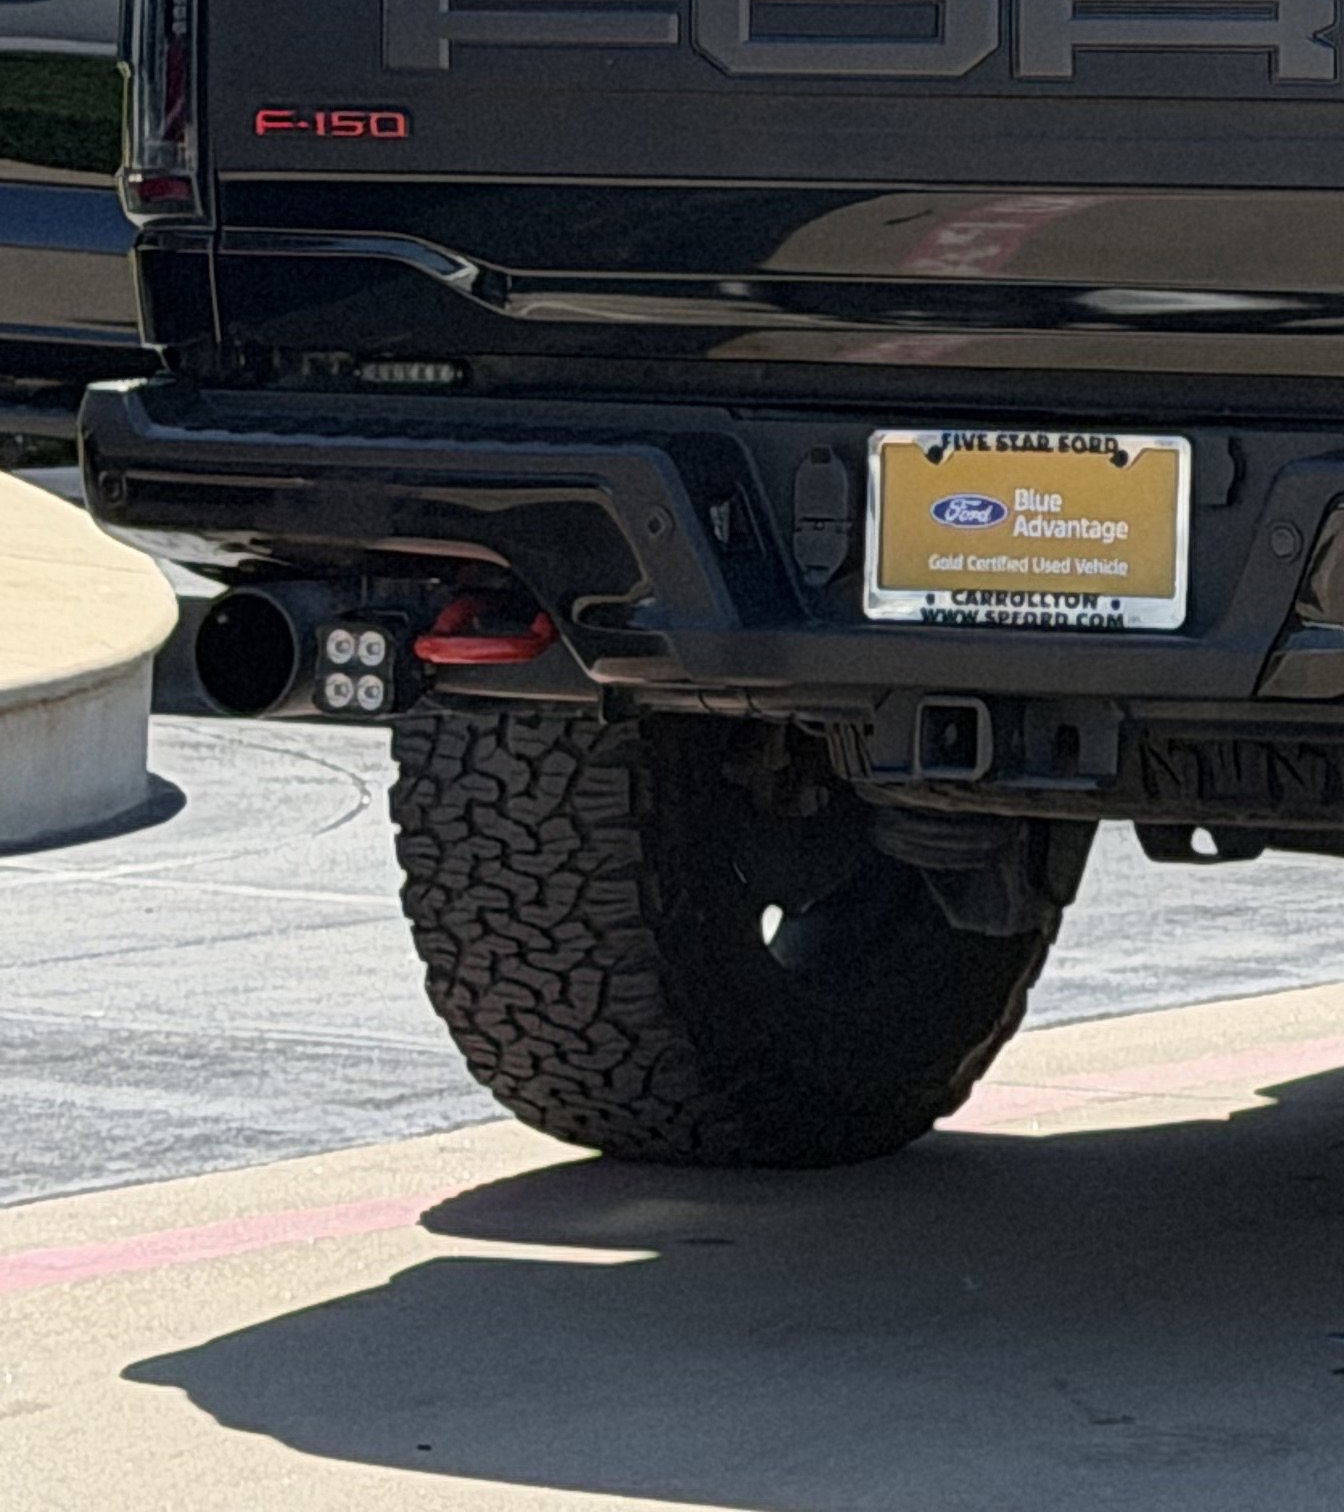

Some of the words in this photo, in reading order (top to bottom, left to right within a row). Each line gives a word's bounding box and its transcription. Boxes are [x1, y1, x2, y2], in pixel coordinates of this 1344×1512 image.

[255, 108, 409, 138] F-150
[940, 432, 991, 452] FIVE
[995, 433, 1054, 453] STAR
[1058, 435, 1120, 455] FORD
[1014, 489, 1063, 513] Blue
[1013, 515, 1129, 544] Advantage
[928, 553, 963, 571] Gold
[967, 554, 1029, 574] Certified
[1033, 556, 1071, 575] Used
[1075, 558, 1129, 577] Vehicle
[950, 589, 1100, 609] CARROLLTON
